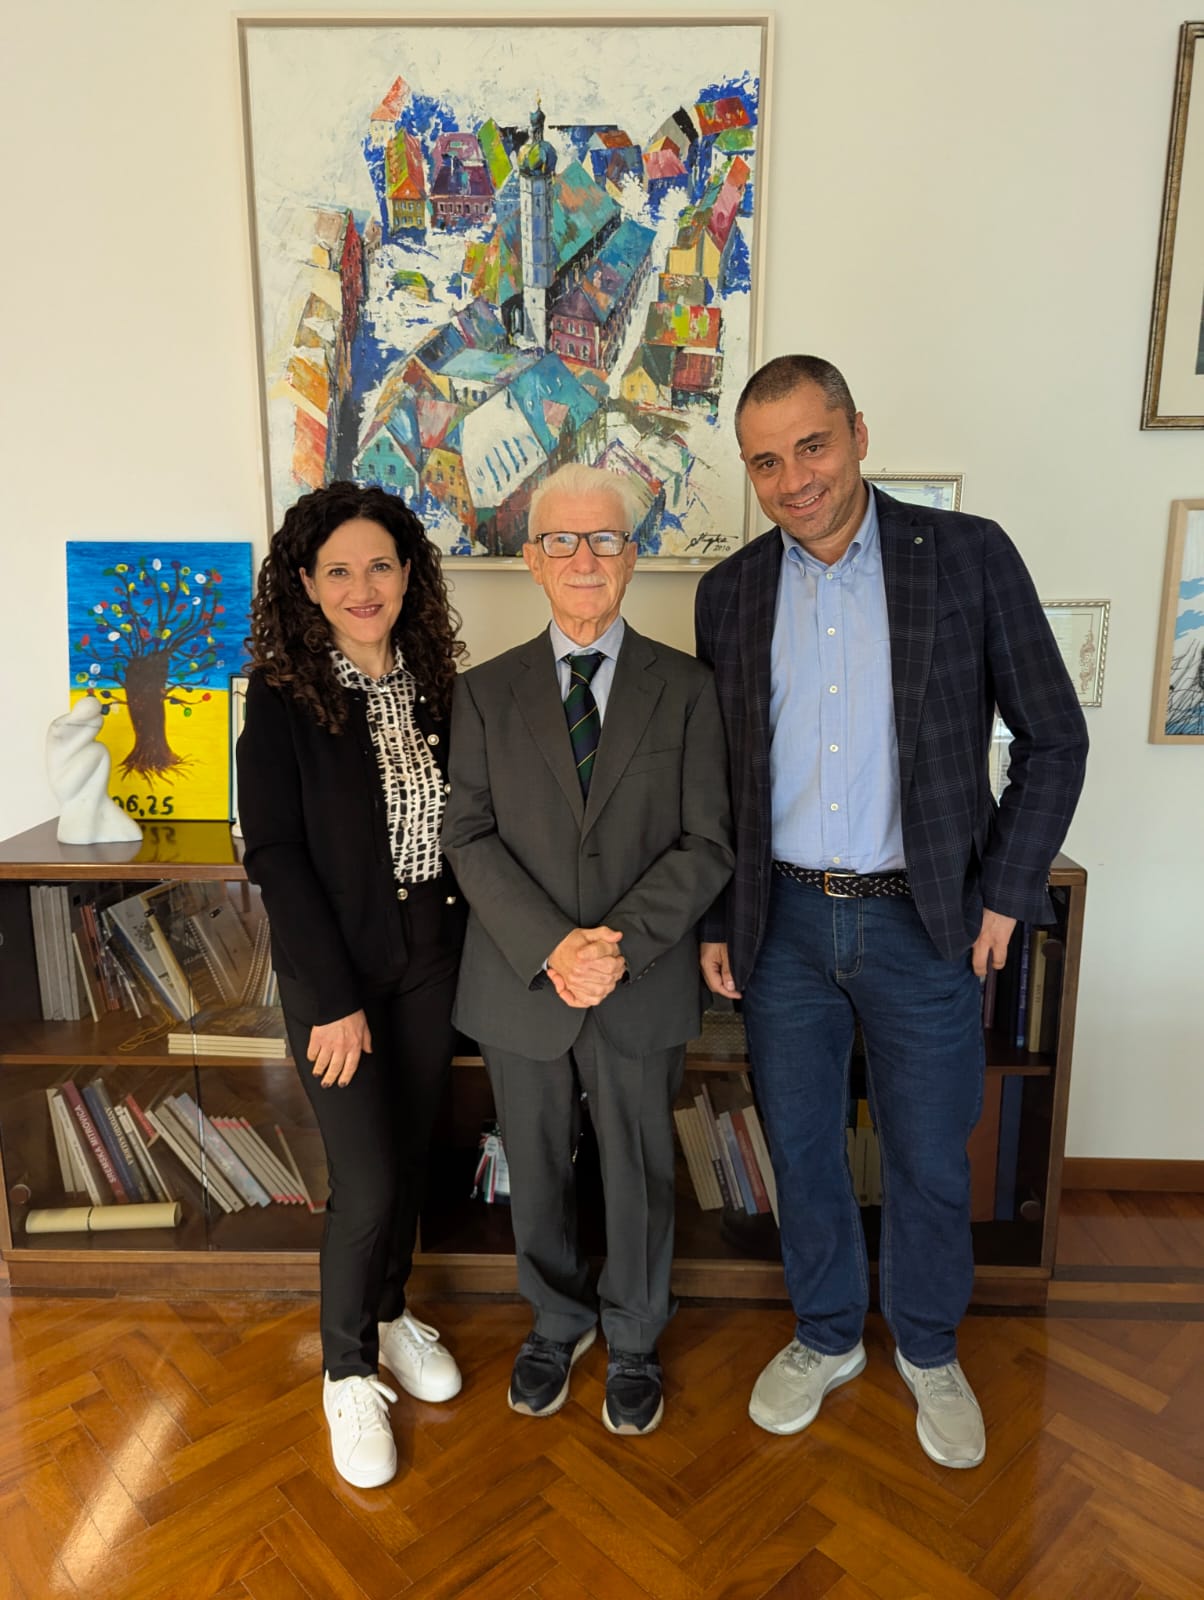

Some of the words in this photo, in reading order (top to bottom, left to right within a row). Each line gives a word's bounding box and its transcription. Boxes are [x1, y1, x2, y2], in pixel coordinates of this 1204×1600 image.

[74, 1104, 98, 1147] MITROVICA
[104, 1105, 122, 1137] ANTONIO
[94, 1145, 117, 1184] SREMSKA
